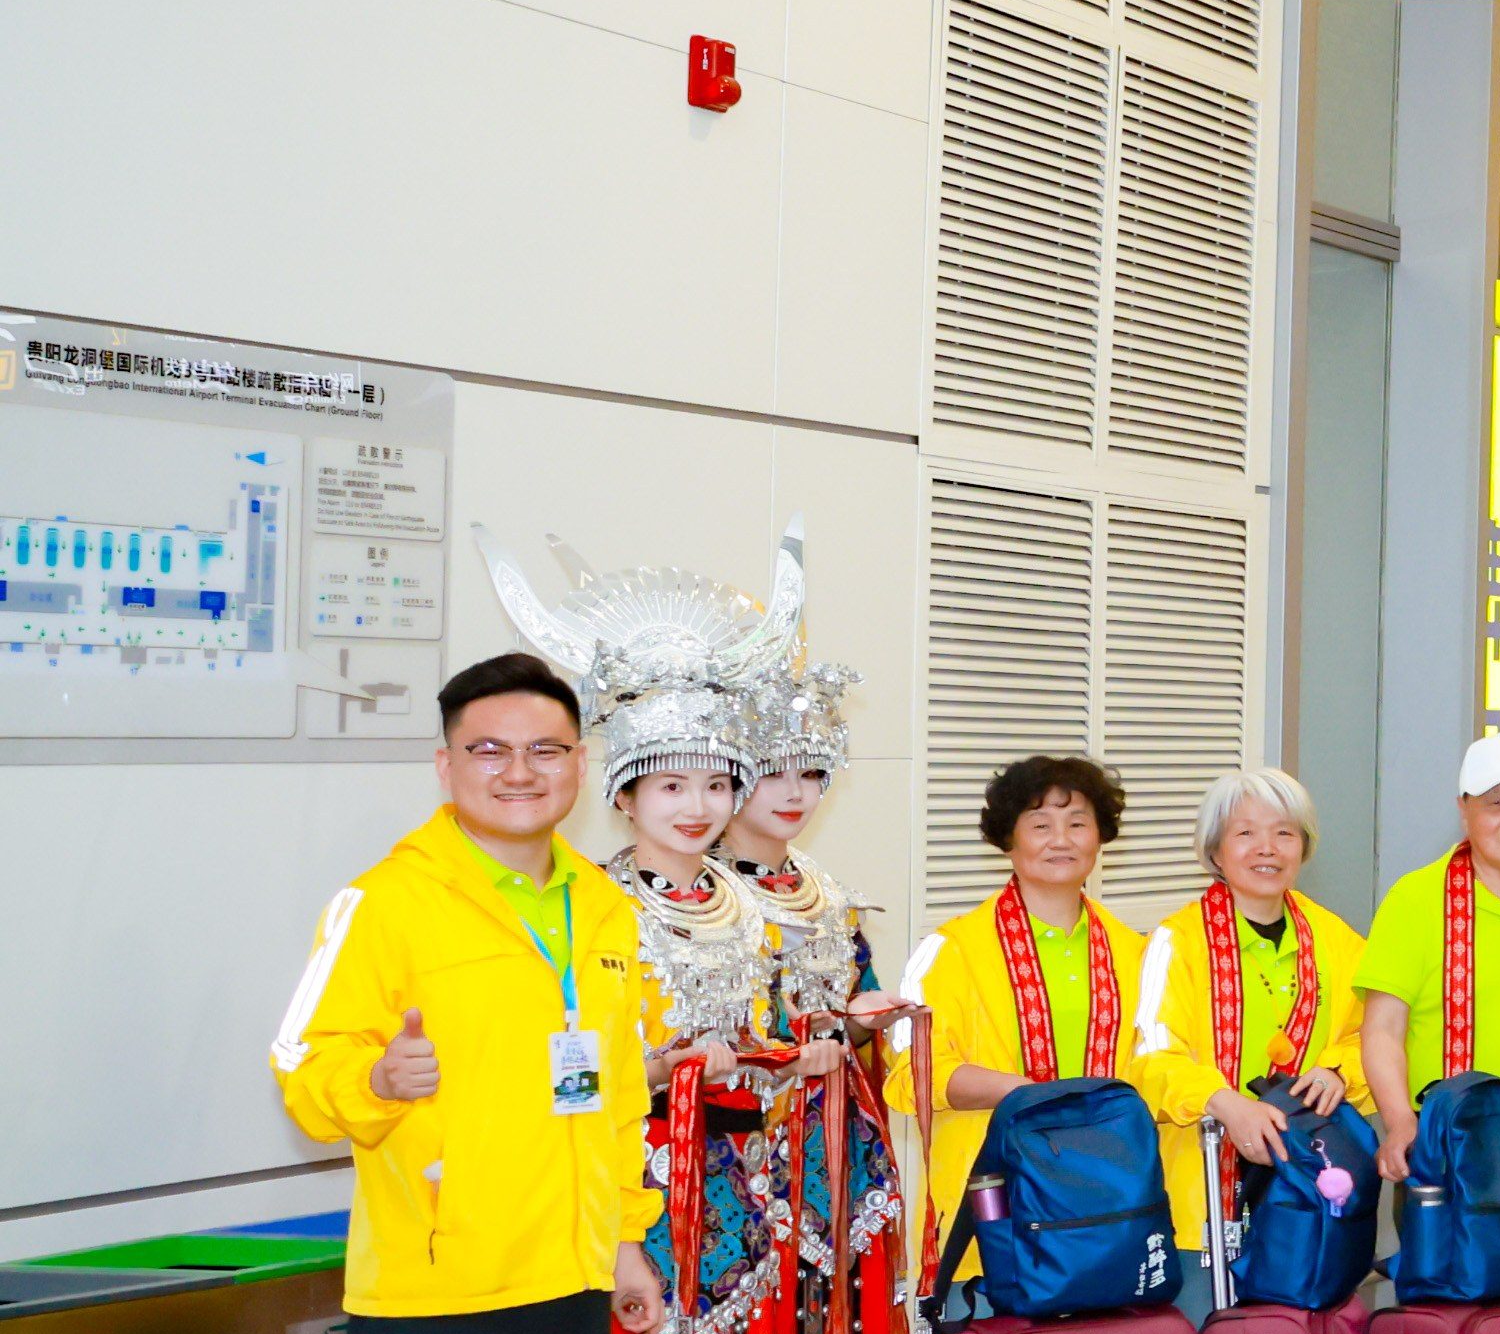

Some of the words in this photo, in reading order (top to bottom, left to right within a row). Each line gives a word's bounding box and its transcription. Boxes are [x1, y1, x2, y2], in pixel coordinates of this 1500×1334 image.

[132, 381, 187, 398] International
[188, 389, 219, 402] Airport
[221, 392, 256, 406] Terminal
[305, 402, 326, 414] Chart
